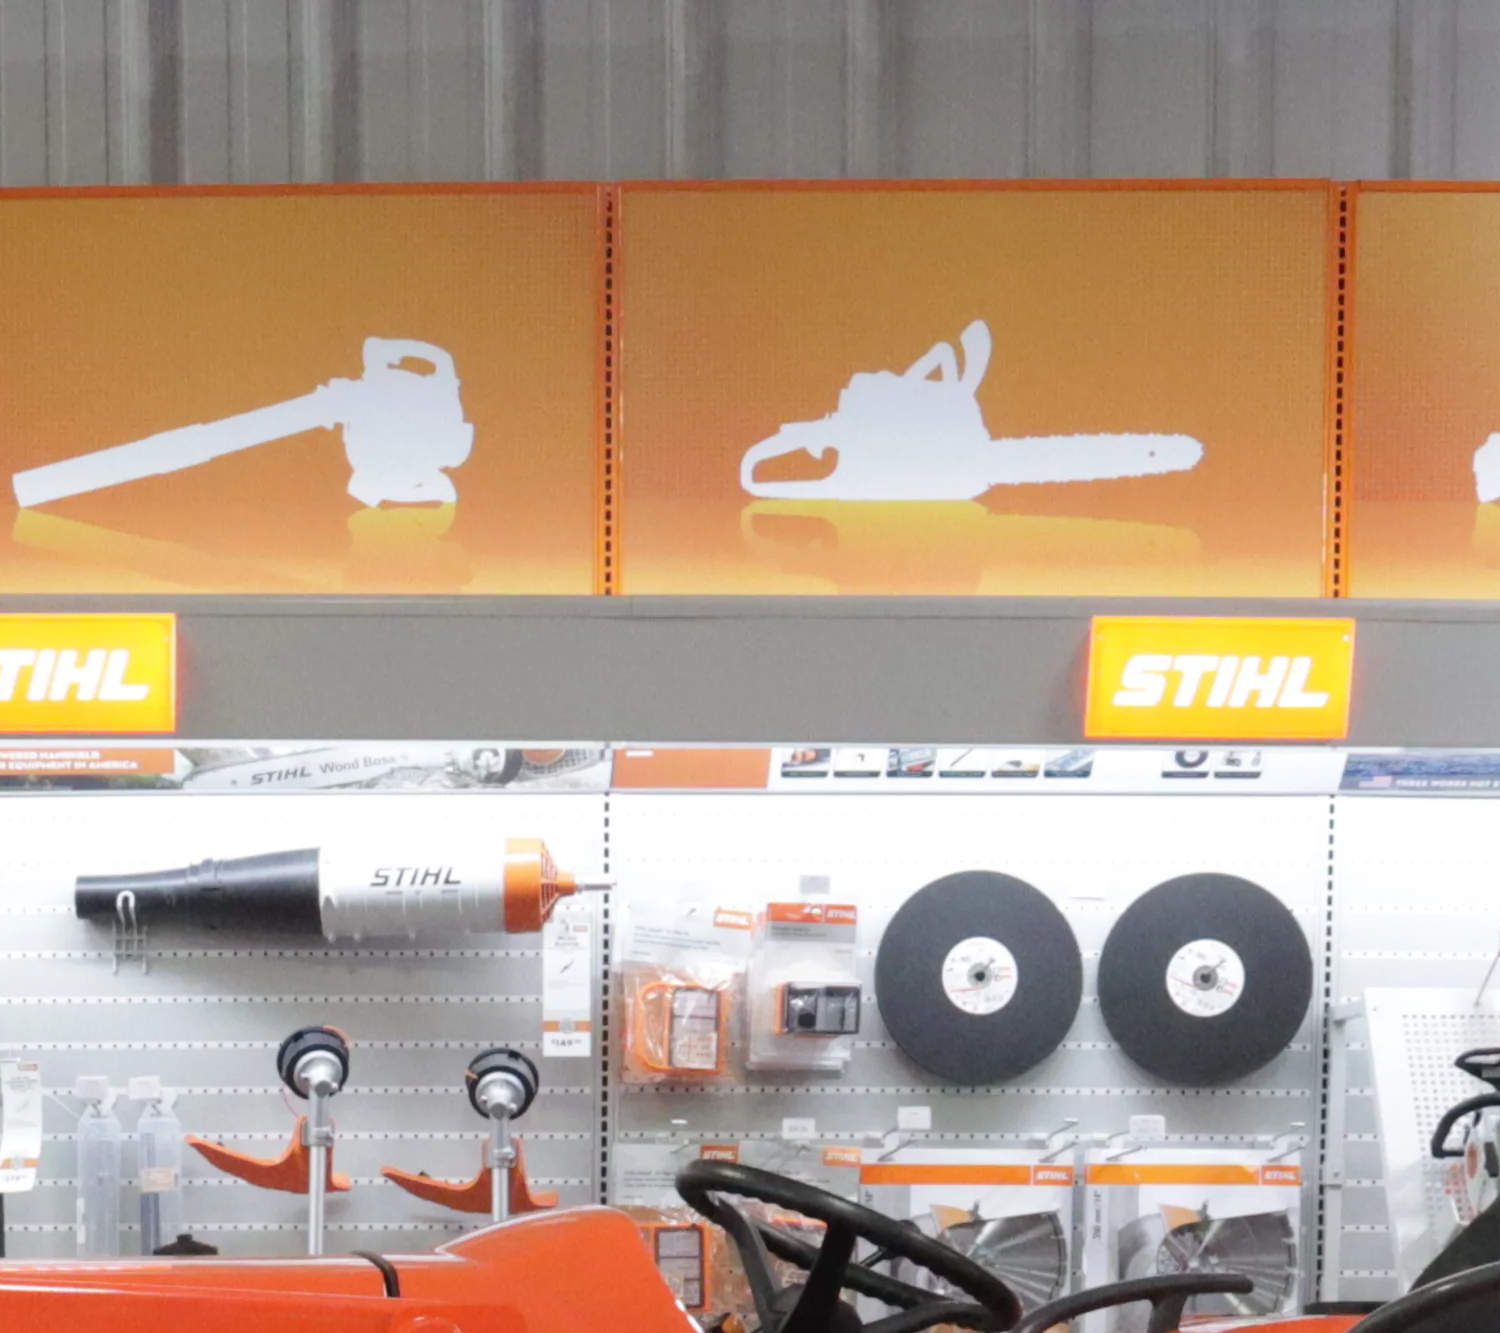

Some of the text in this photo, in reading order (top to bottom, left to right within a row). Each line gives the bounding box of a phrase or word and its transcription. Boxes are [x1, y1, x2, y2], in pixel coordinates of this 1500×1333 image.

[1113, 654, 1330, 707] STIHL
[251, 753, 397, 785] STIHL Wood Boss
[370, 866, 462, 887] STIHL
[715, 912, 750, 926] STIHL
[703, 1149, 737, 1161] STIHL
[1036, 1170, 1069, 1180] STIHL
[1264, 1170, 1296, 1180] STIHL
